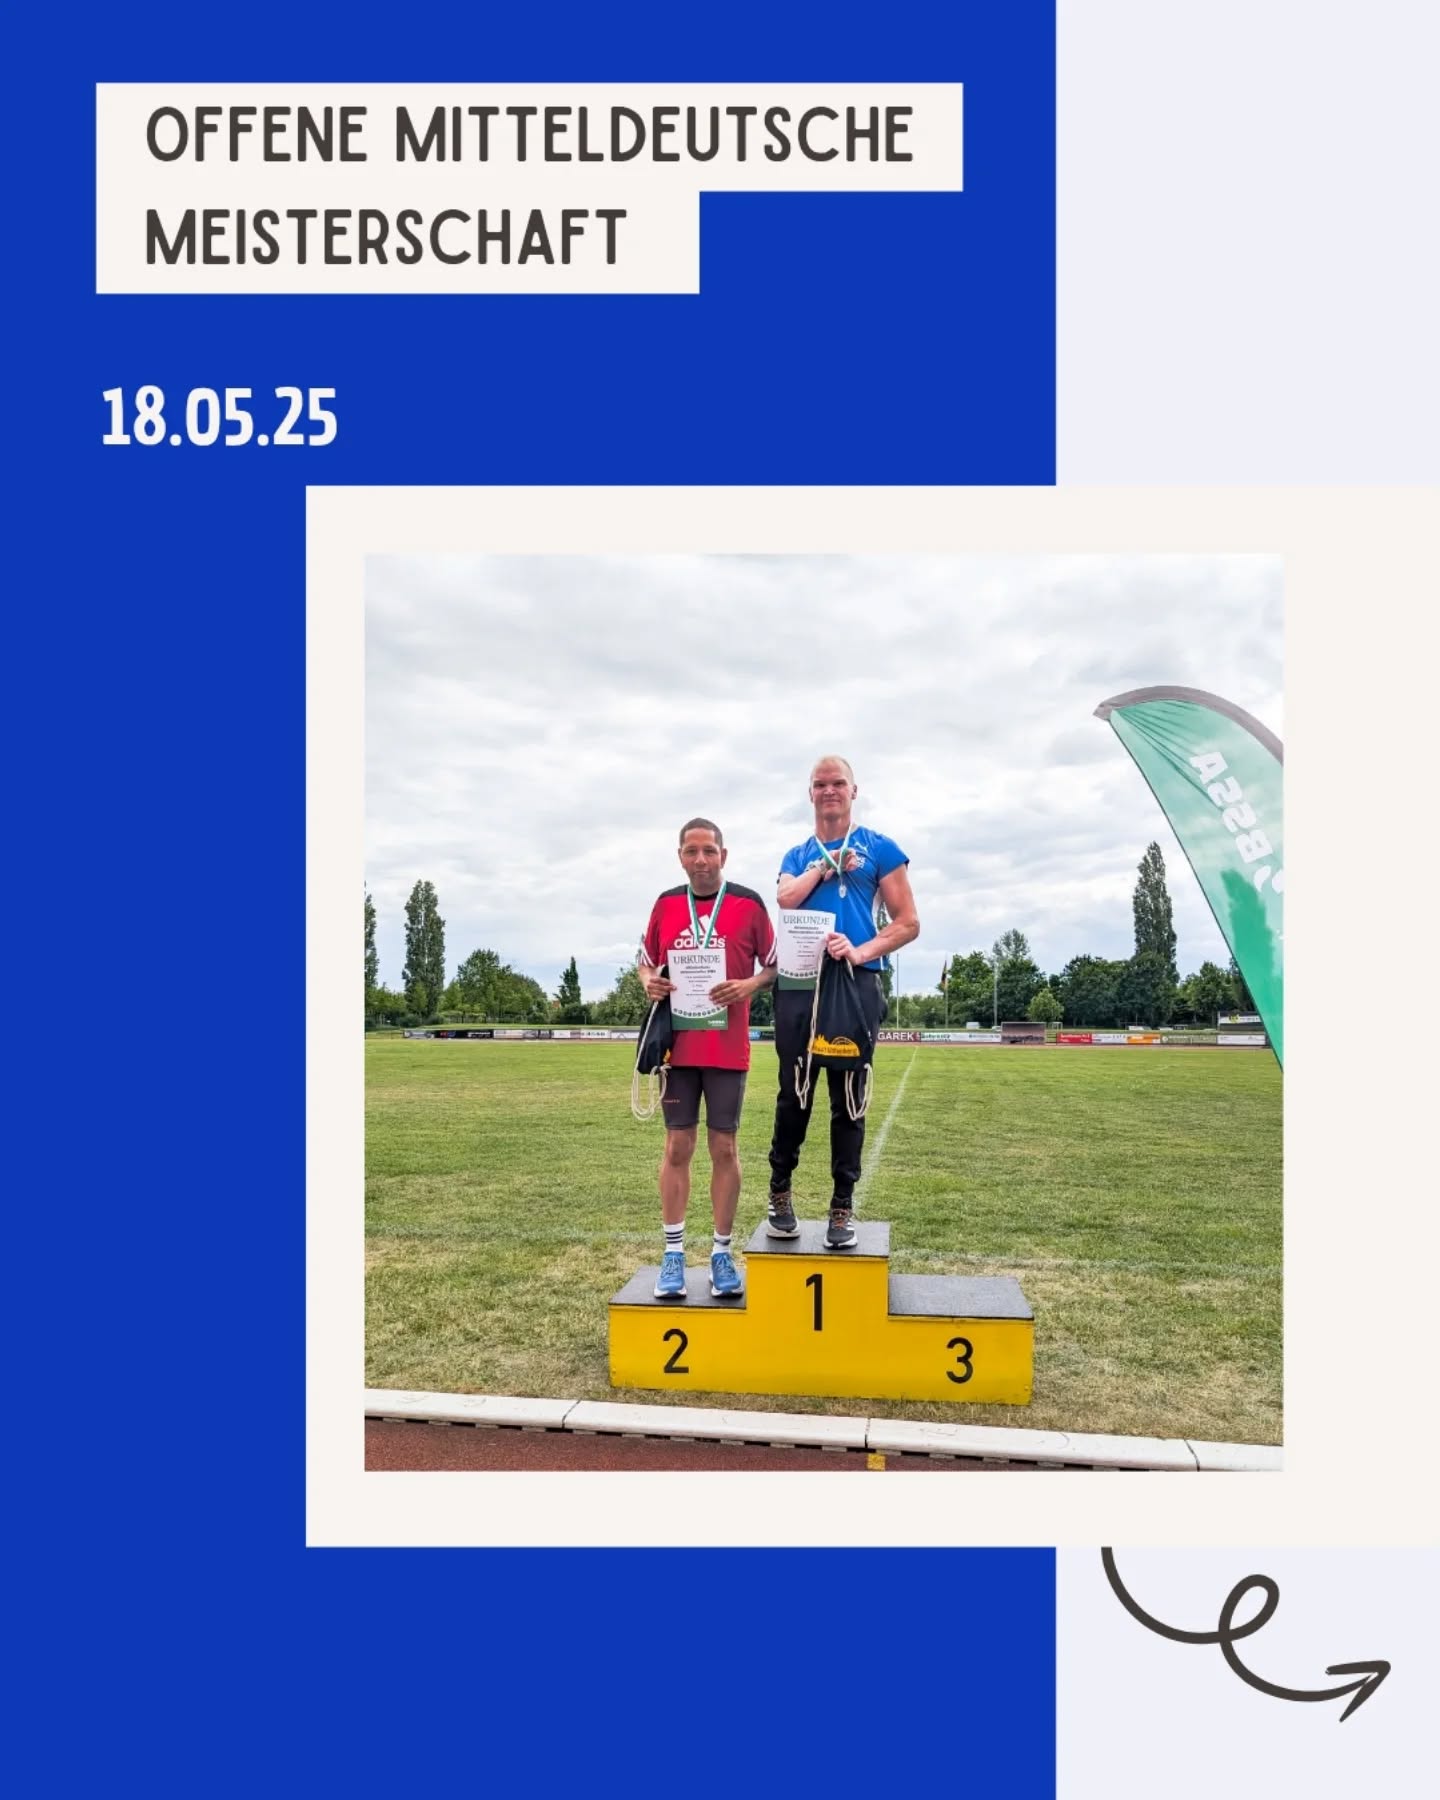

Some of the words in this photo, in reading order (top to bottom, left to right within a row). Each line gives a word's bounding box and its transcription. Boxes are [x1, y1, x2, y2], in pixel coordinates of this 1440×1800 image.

[783, 915, 830, 925] URKUNDE
[673, 935, 726, 949] adas
[673, 954, 720, 965] URKUNDE
[805, 1273, 823, 1332] 1
[662, 1329, 689, 1374] 2
[946, 1337, 974, 1384] 3
